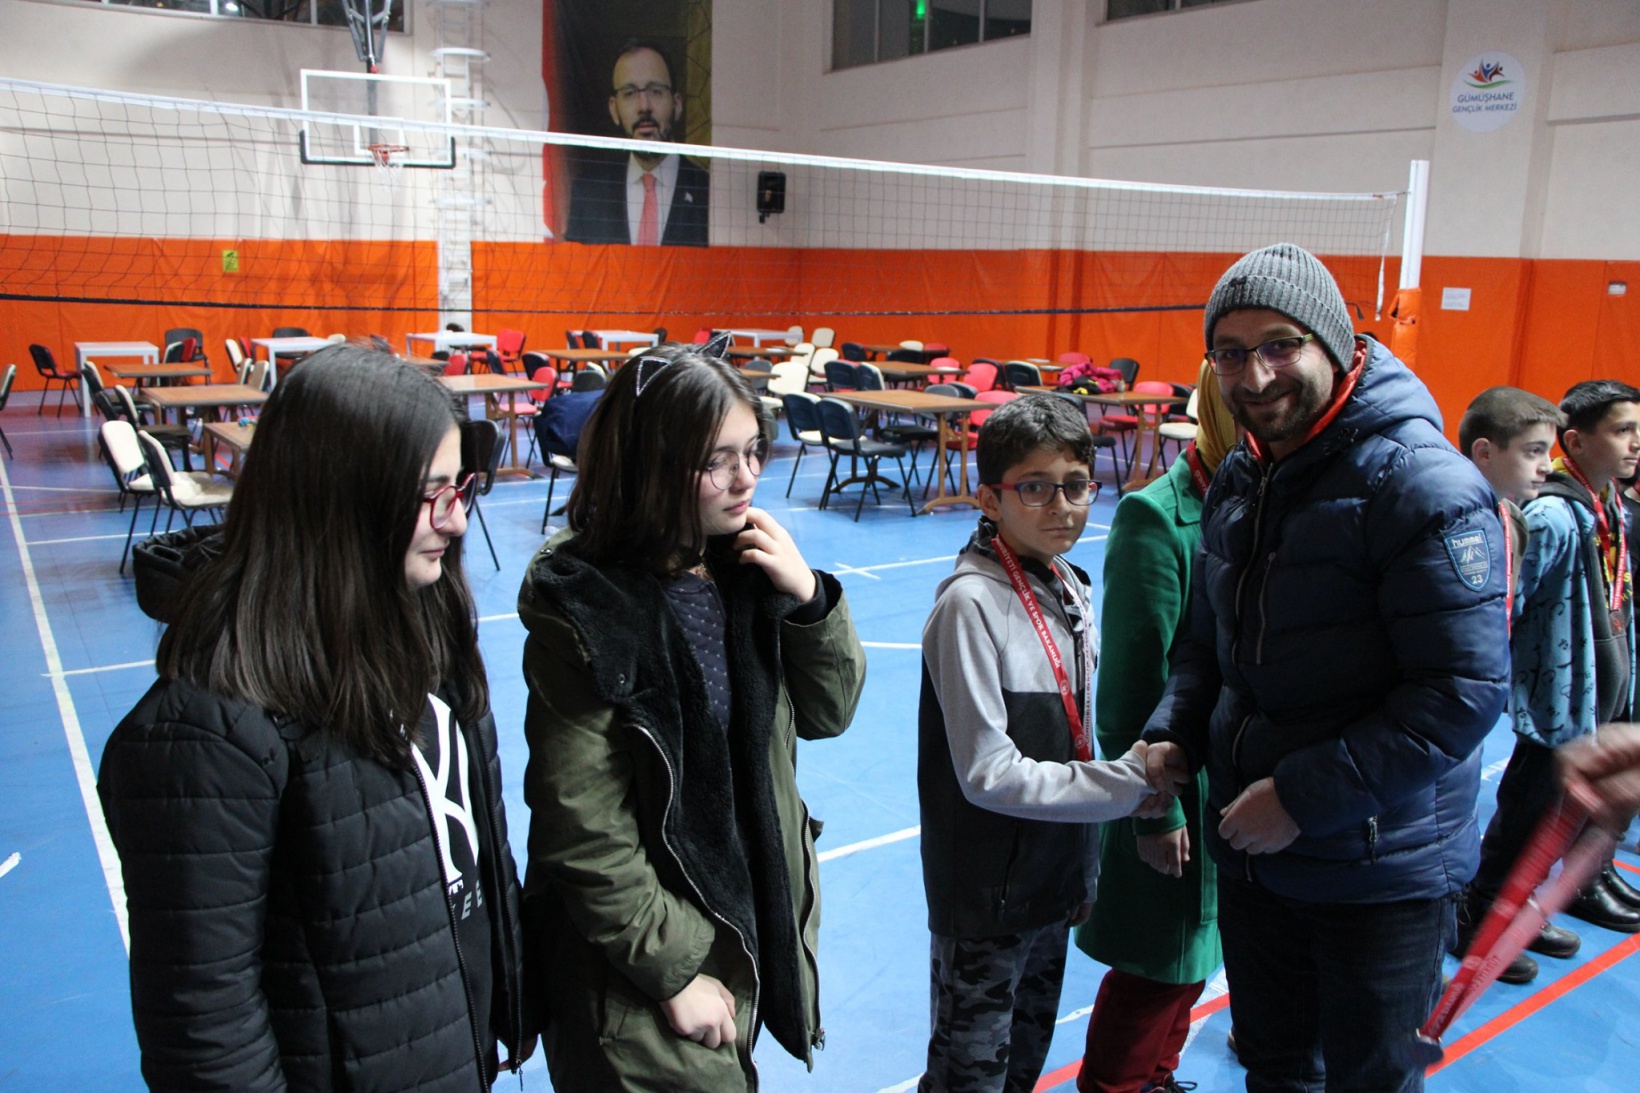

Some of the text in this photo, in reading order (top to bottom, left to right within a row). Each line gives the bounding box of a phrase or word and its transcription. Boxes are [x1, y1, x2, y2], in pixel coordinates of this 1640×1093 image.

[1457, 92, 1515, 103] GÜMÜŞHANE
[1452, 103, 1517, 114] GENÇLİK MERKEZİ
[1471, 574, 1484, 585] 23
[1028, 600, 1036, 611] VE
[1032, 611, 1045, 630] SPOR
[1041, 630, 1062, 668] BAKANLIĞI
